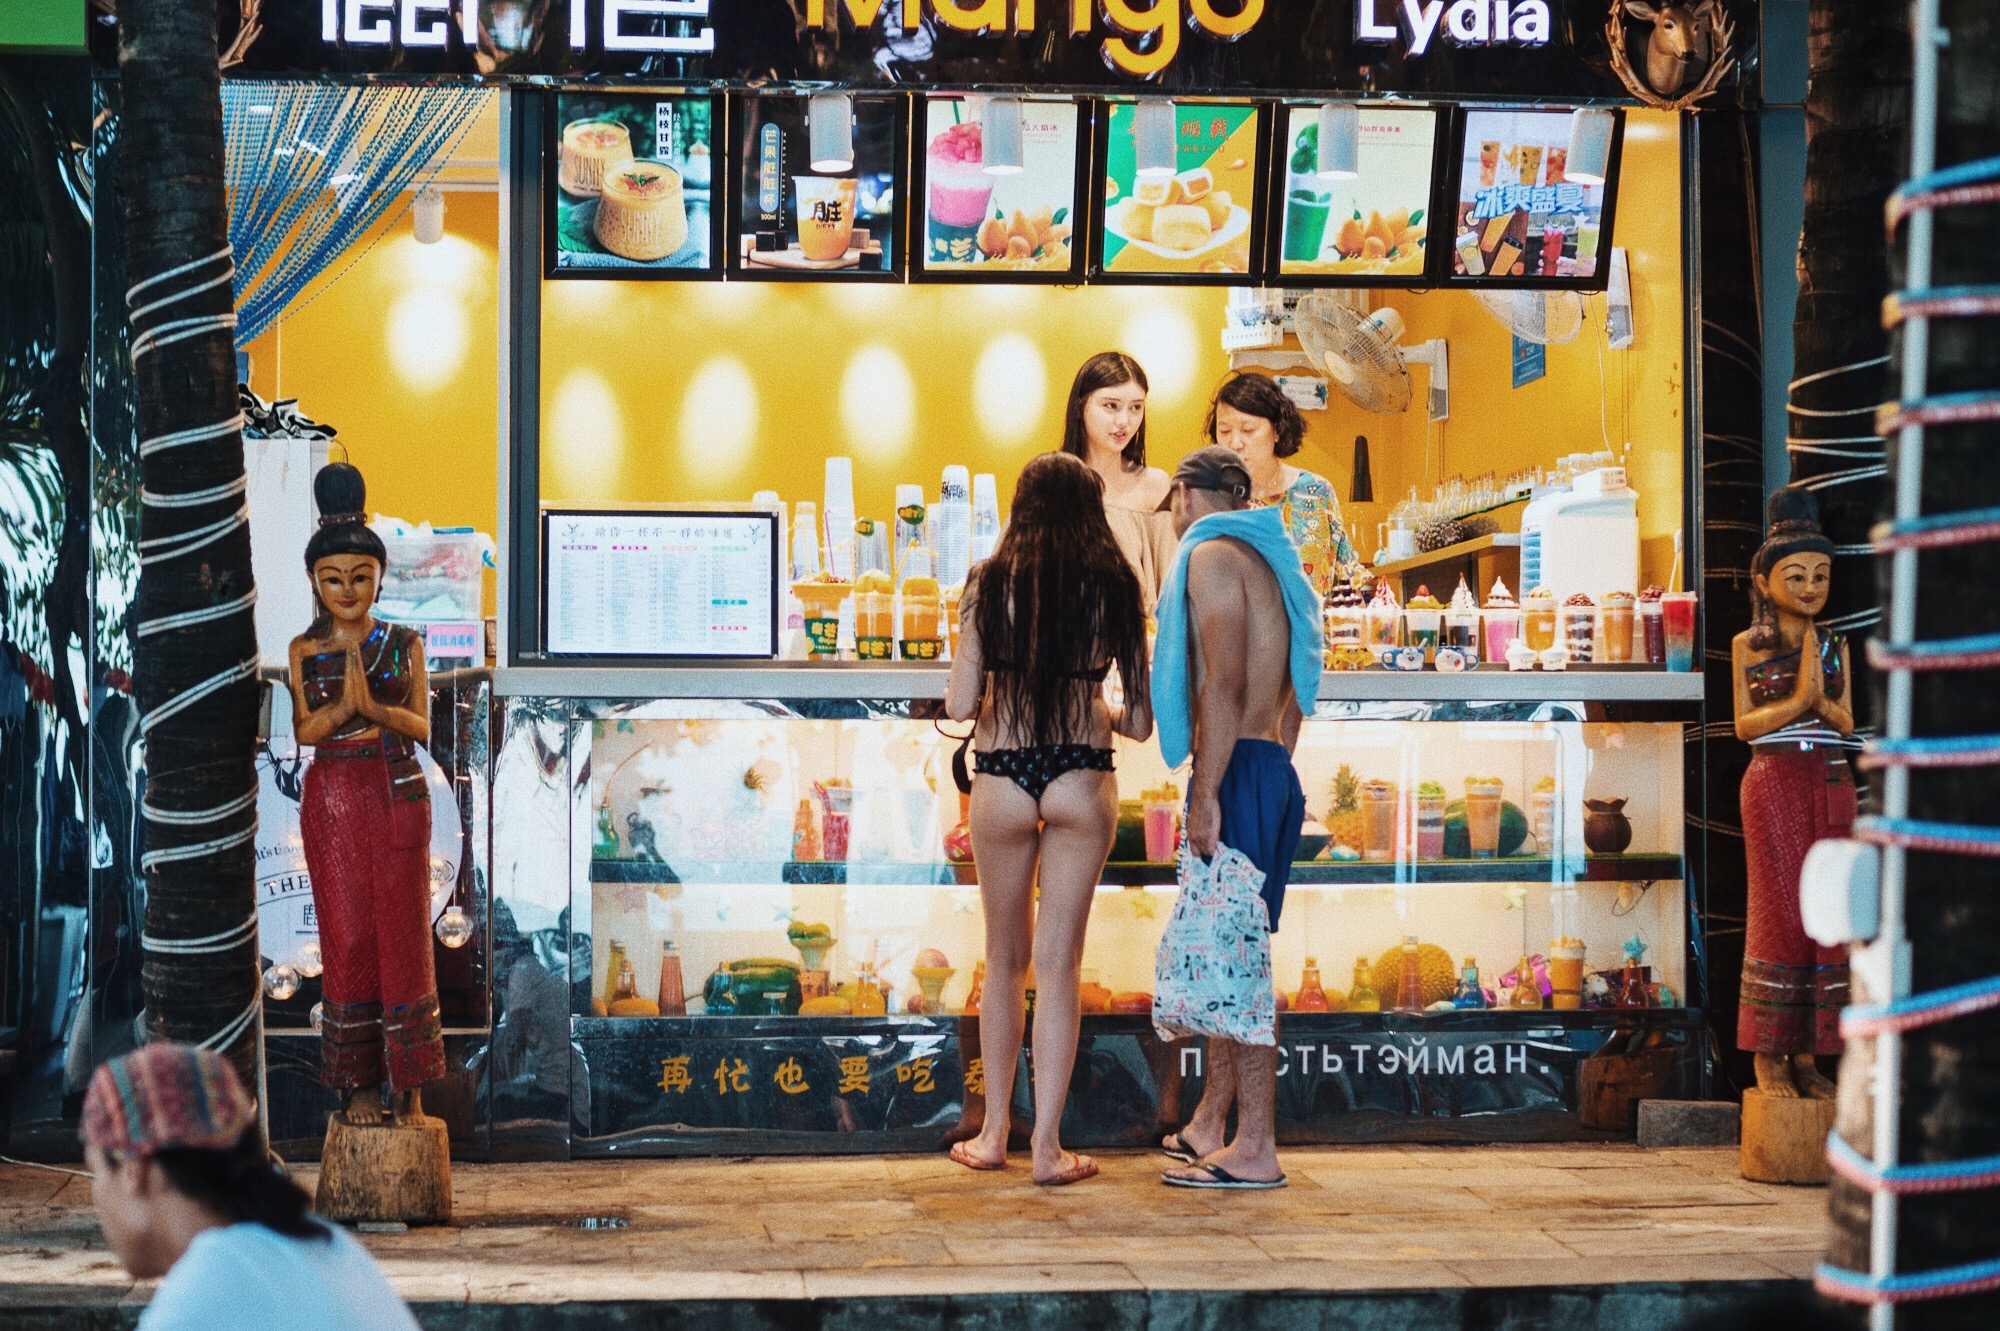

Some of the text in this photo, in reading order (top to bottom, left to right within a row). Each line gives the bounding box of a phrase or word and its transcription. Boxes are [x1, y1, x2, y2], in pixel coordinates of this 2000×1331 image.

[1358, 0, 1550, 54] Lydia
[658, 107, 670, 155] 杨枝甘露
[763, 129, 777, 206] 芒果脏脏杯
[812, 200, 842, 222] 脏
[1473, 183, 1587, 219] 冰爽盛夏
[263, 875, 311, 895] THE
